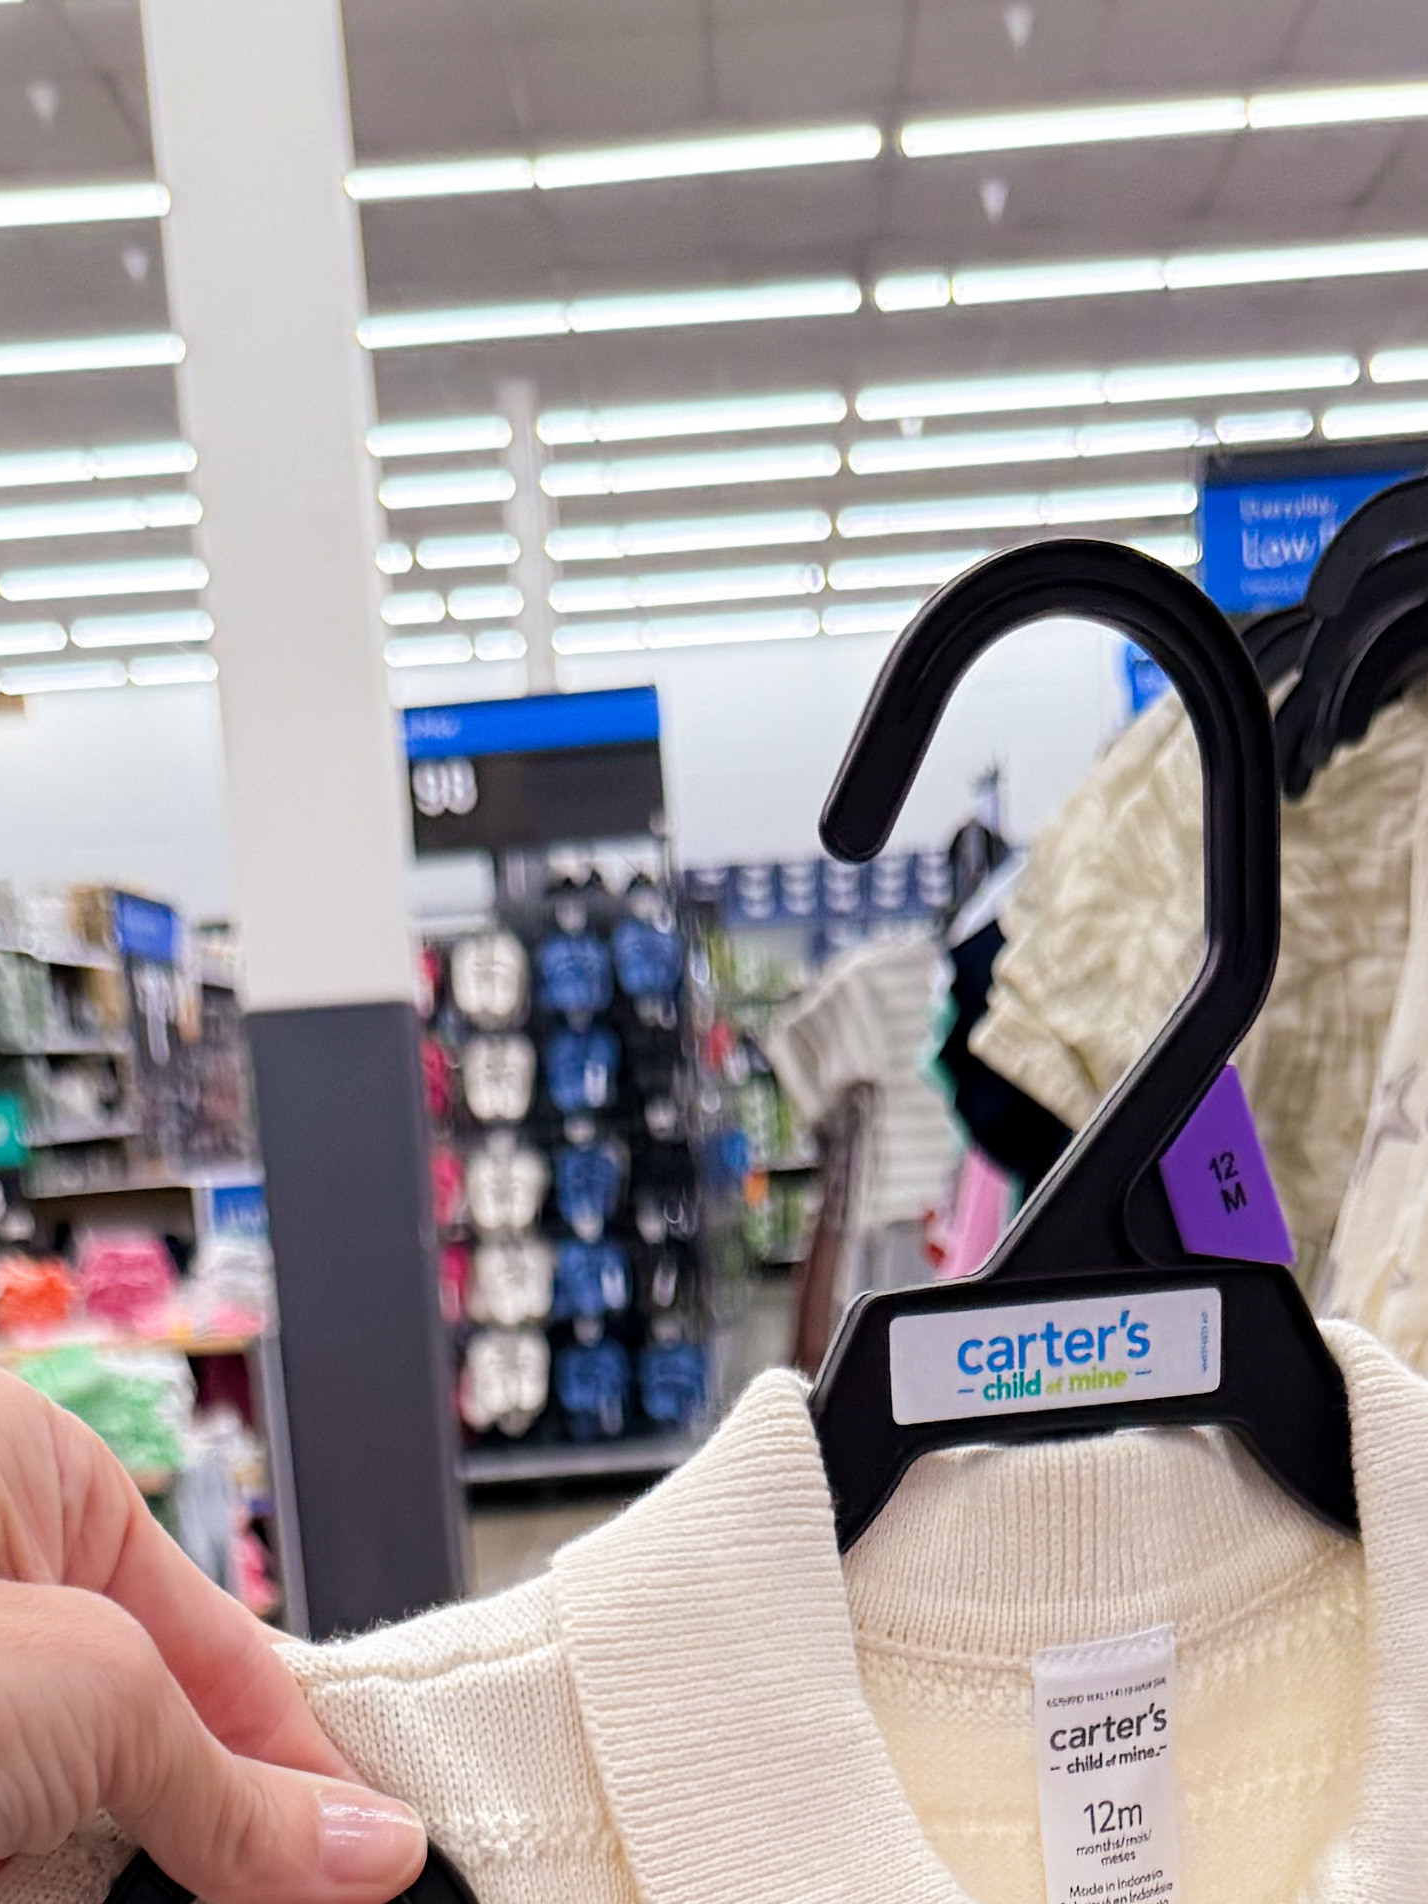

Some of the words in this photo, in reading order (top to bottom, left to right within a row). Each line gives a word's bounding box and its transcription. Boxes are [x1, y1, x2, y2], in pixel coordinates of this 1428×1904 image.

[1209, 1152, 1239, 1183] 12
[1221, 1181, 1247, 1214] M
[957, 1310, 1151, 1375] carter's
[982, 1369, 1041, 1401] child
[1068, 1366, 1128, 1392] mine
[1050, 1702, 1167, 1751] carter's
[1067, 1752, 1103, 1774] child
[1083, 1800, 1143, 1835] 12m
[1100, 1850, 1136, 1866] meses
[1070, 1882, 1104, 1898] Made
[1106, 1882, 1116, 1893] in
